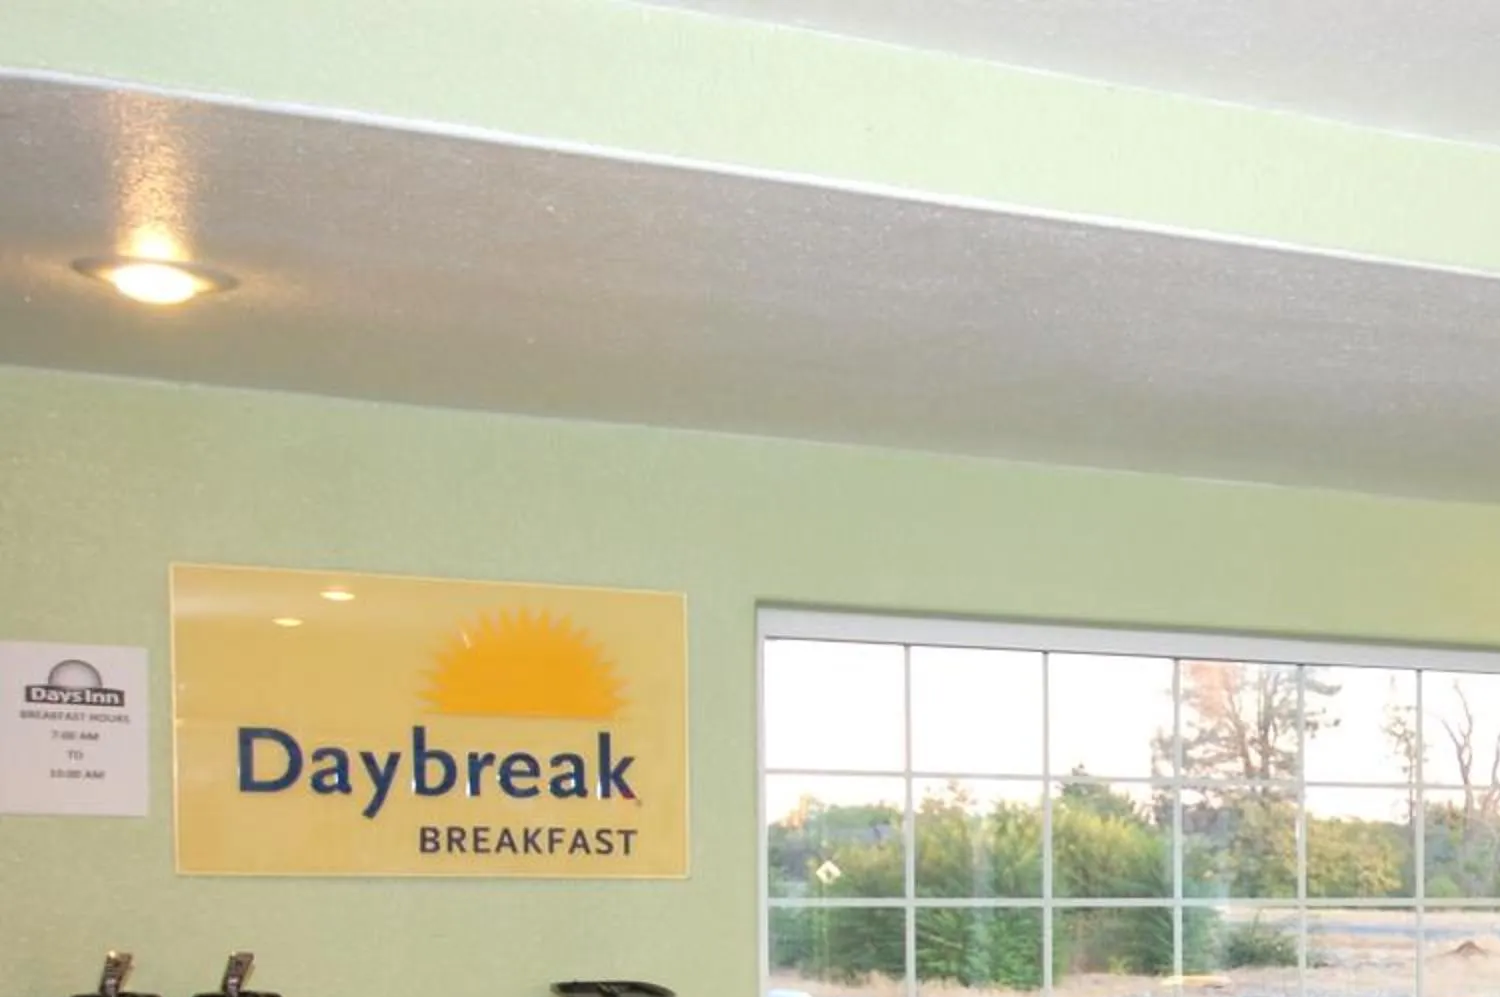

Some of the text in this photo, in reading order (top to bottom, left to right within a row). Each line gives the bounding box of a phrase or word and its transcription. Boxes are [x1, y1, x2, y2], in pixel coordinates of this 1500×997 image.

[19, 710, 131, 724] BREAKFAST HOURS
[236, 726, 638, 819] Daybreak
[419, 825, 638, 856] BREAKFAST
